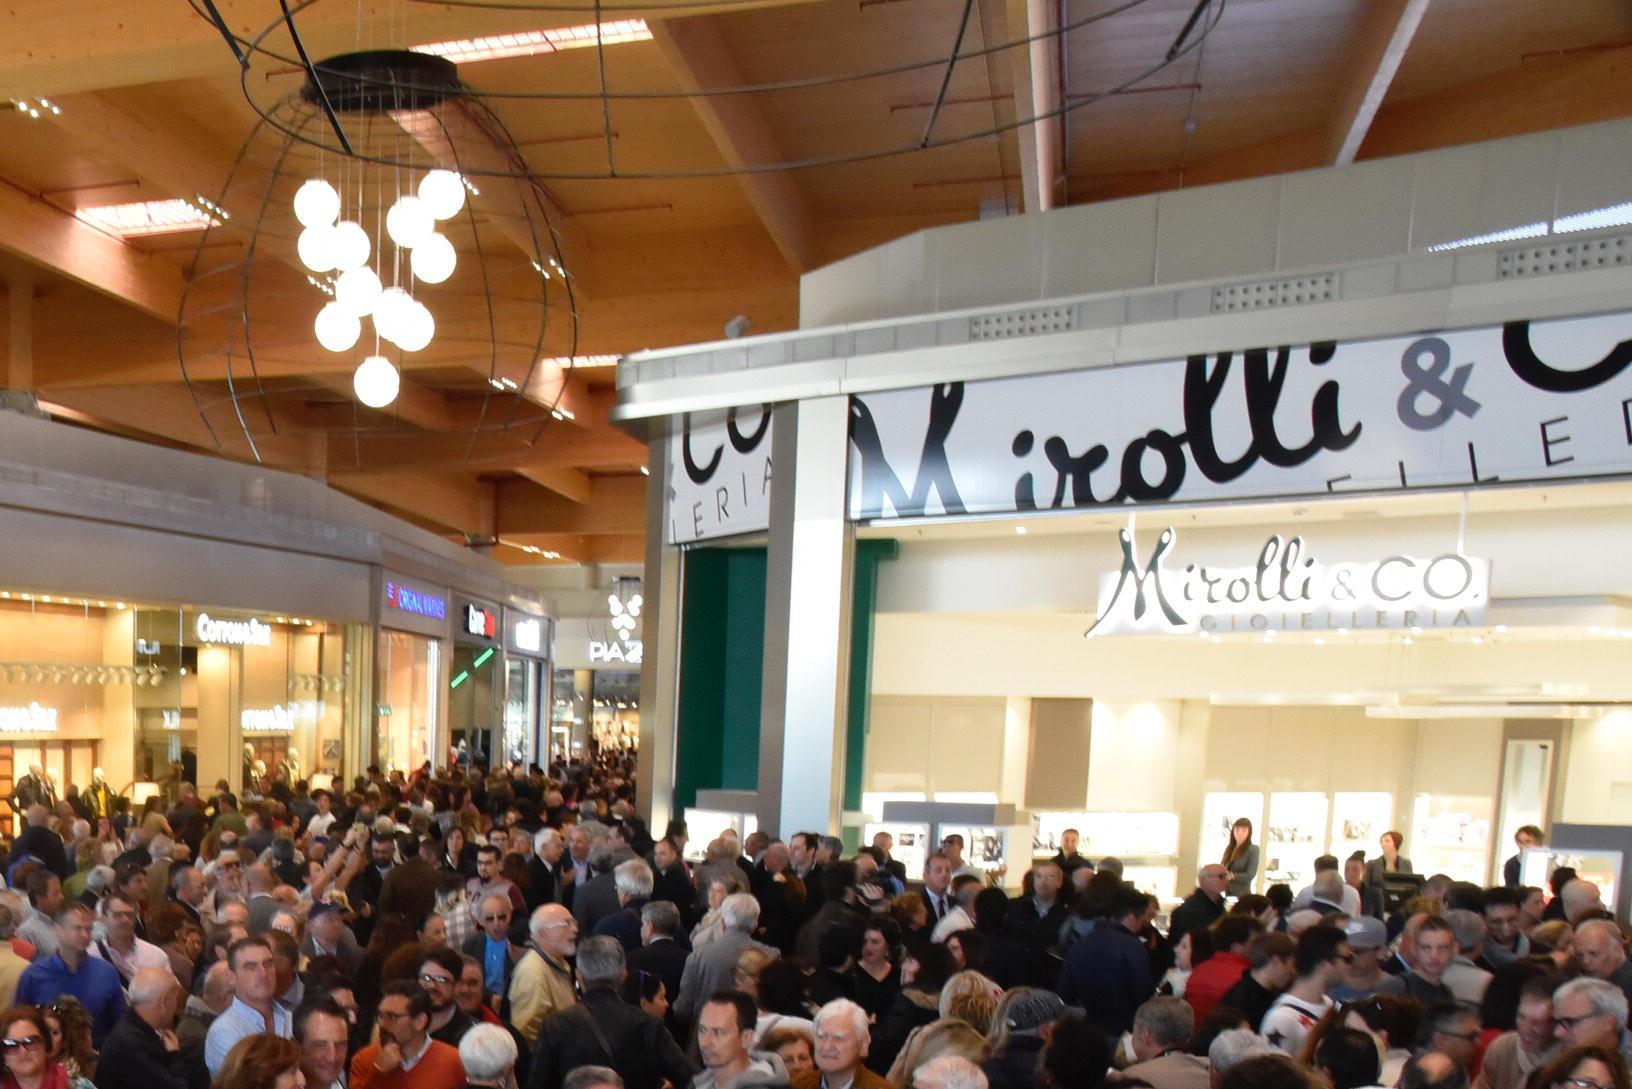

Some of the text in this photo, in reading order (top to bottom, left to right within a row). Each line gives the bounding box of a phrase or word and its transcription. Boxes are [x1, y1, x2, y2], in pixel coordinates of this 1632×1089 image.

[1396, 336, 1483, 432] &
[1083, 527, 1316, 638] Mirolli
[1330, 568, 1357, 601] &
[1199, 607, 1472, 631] GIOIELLERIA
